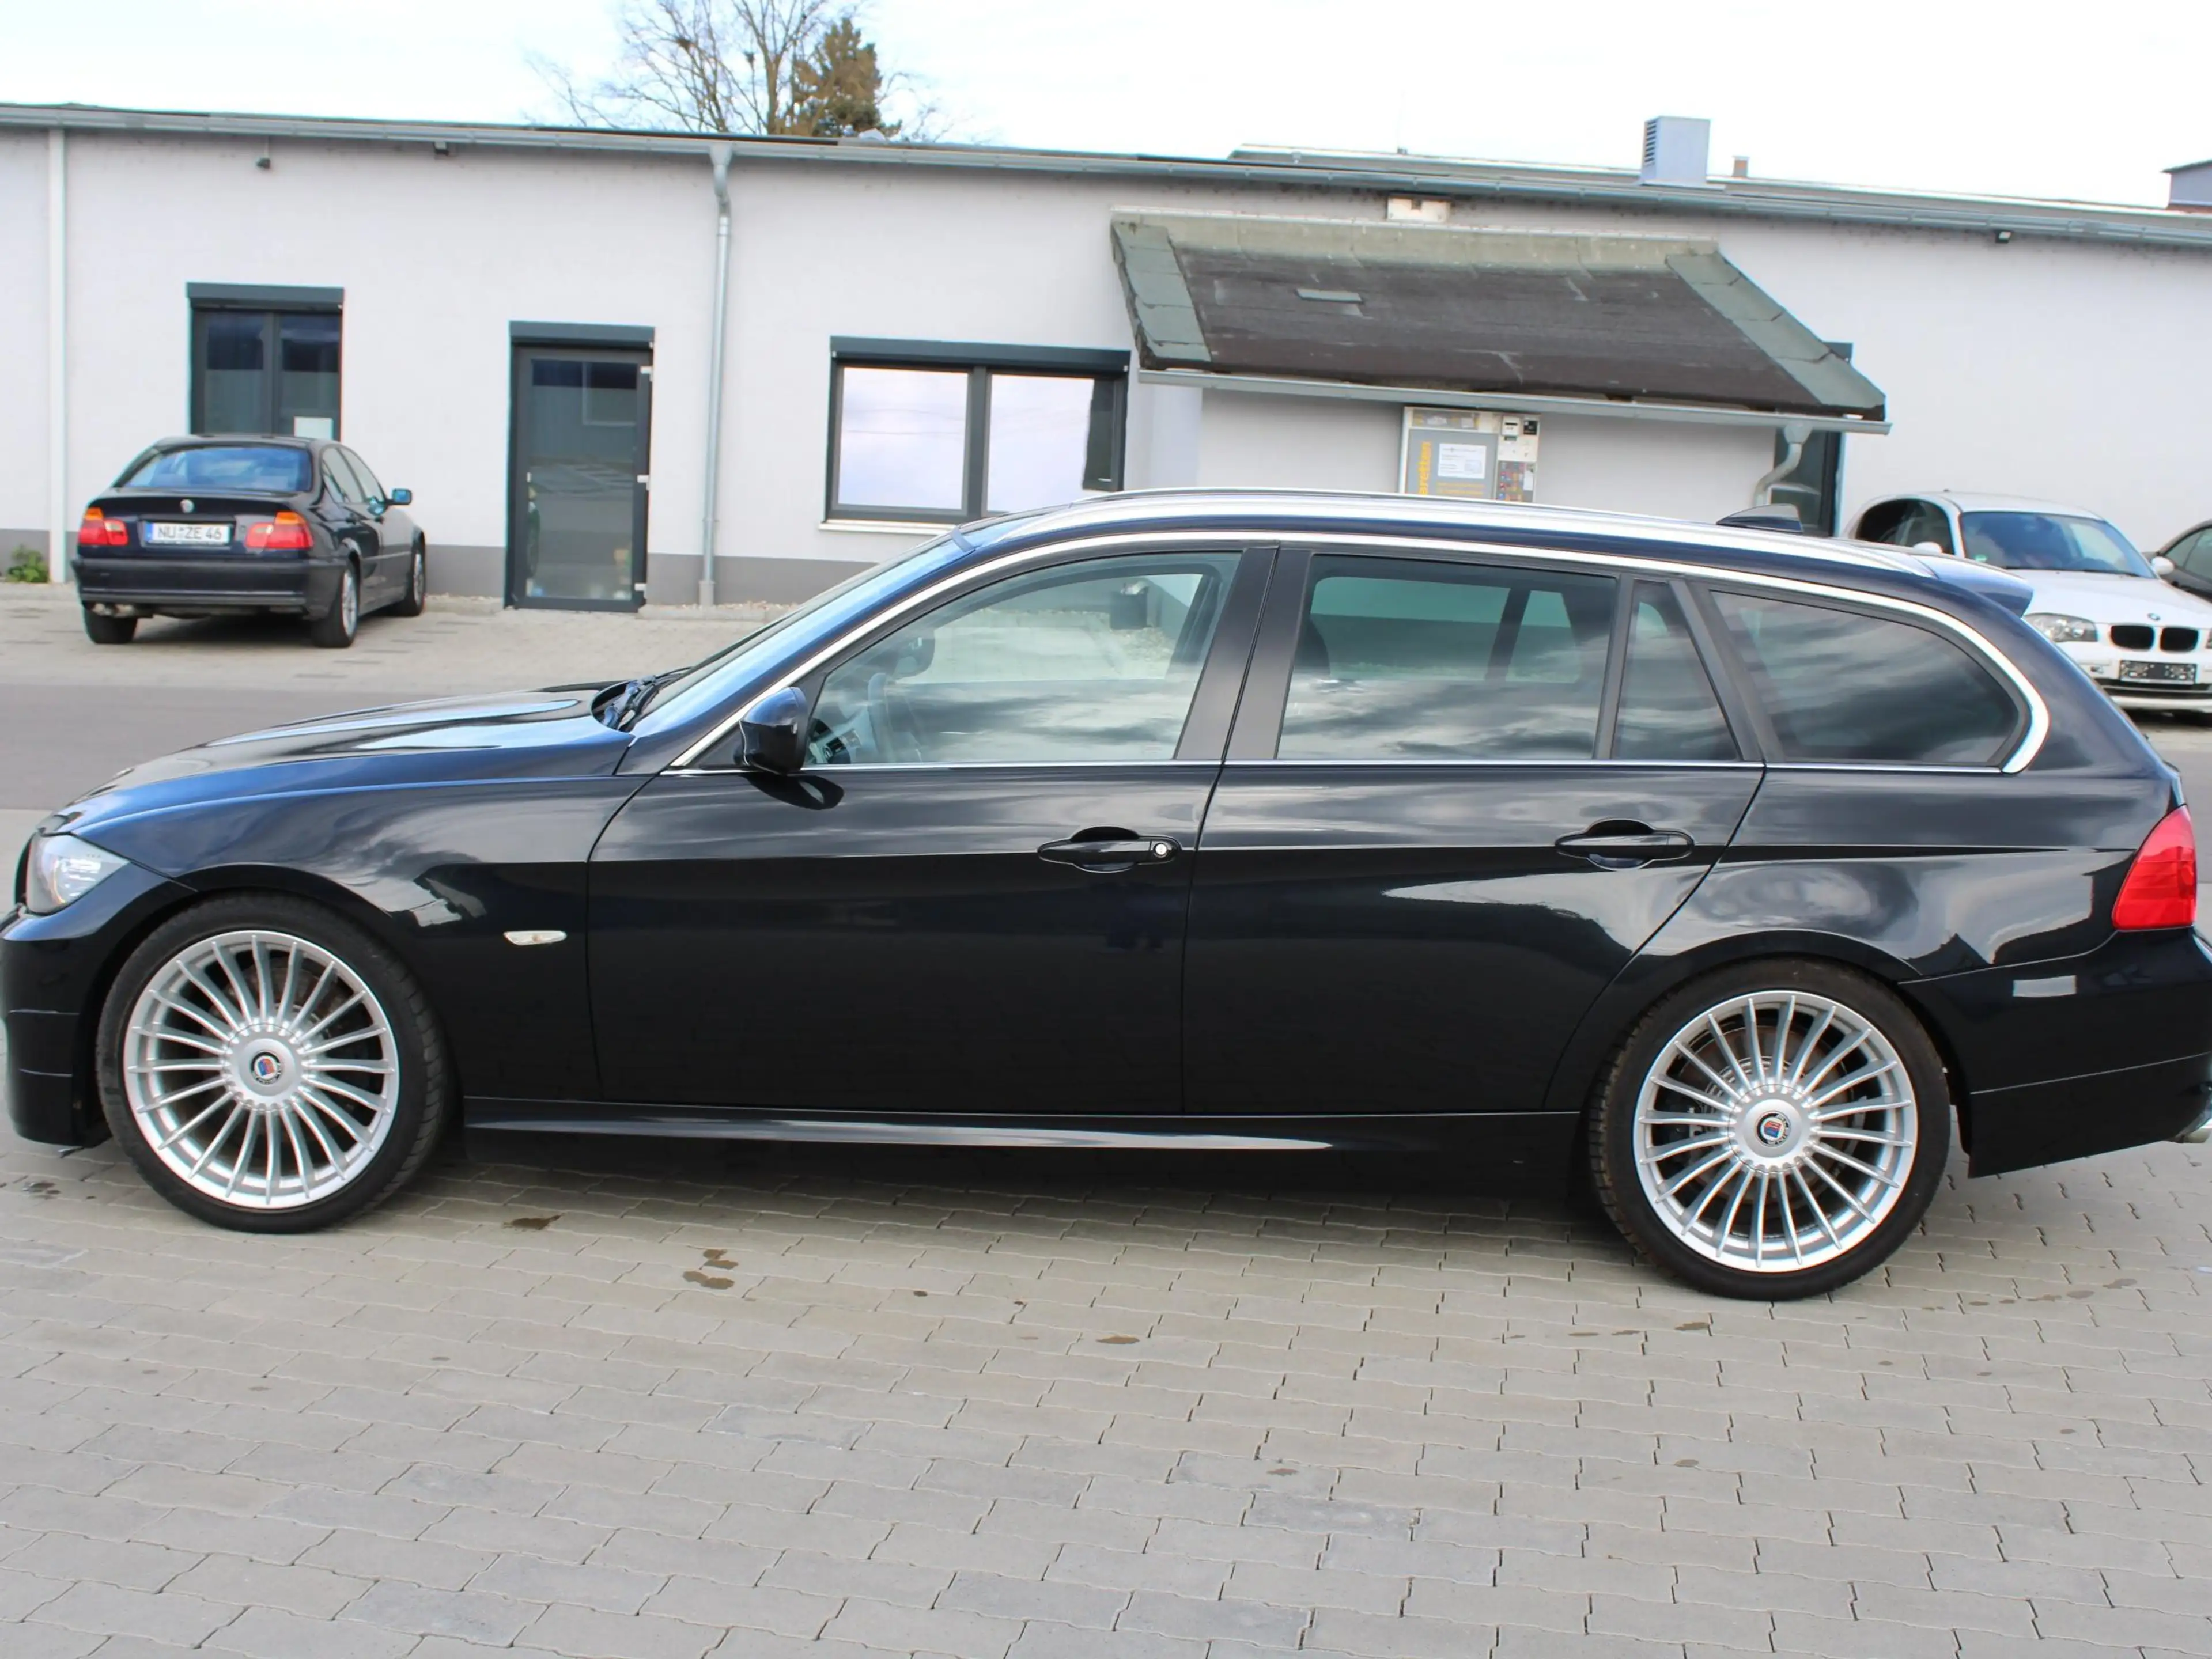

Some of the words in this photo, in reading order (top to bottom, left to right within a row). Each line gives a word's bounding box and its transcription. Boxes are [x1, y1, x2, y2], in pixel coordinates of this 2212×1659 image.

[158, 525, 176, 539] NU
[184, 527, 202, 540] ZE
[205, 527, 222, 540] 46
